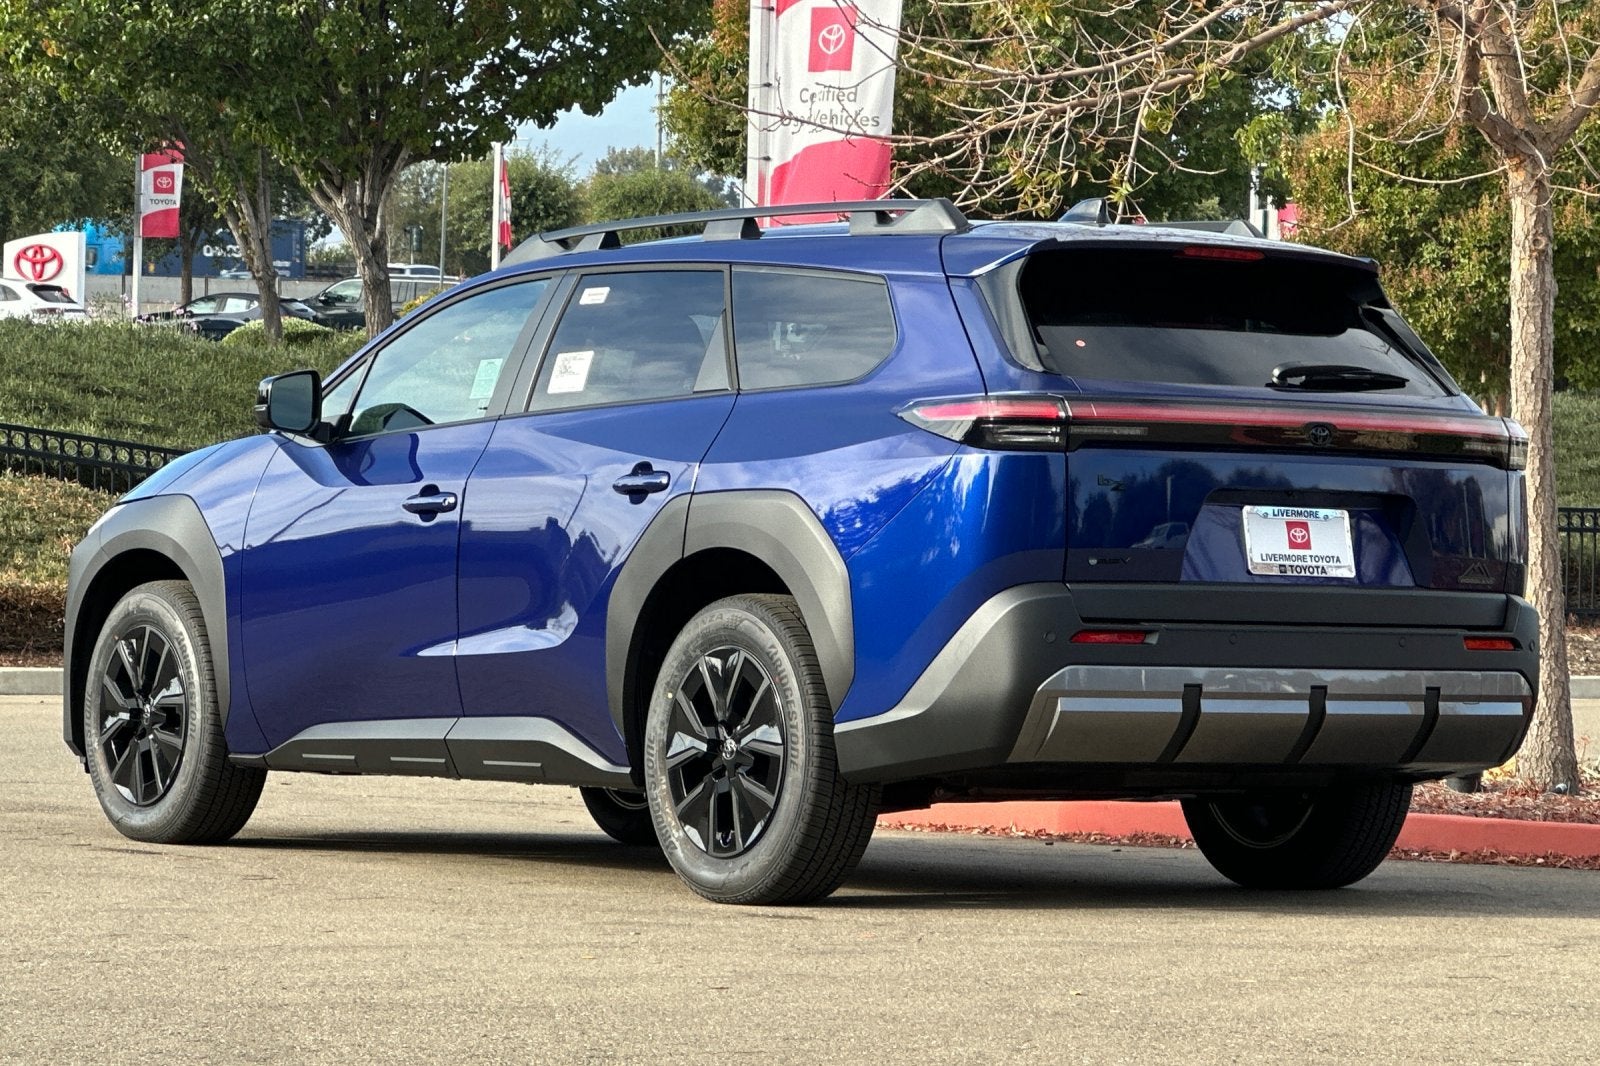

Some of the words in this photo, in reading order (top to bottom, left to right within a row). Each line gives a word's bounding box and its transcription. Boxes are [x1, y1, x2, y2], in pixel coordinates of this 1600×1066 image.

[149, 198, 177, 206] TOYOTA
[1272, 508, 1320, 519] LIVERMORE
[1260, 553, 1308, 563] LIVERMORE
[1308, 555, 1341, 564] TOYOTA
[1288, 564, 1328, 575] TOYOTA
